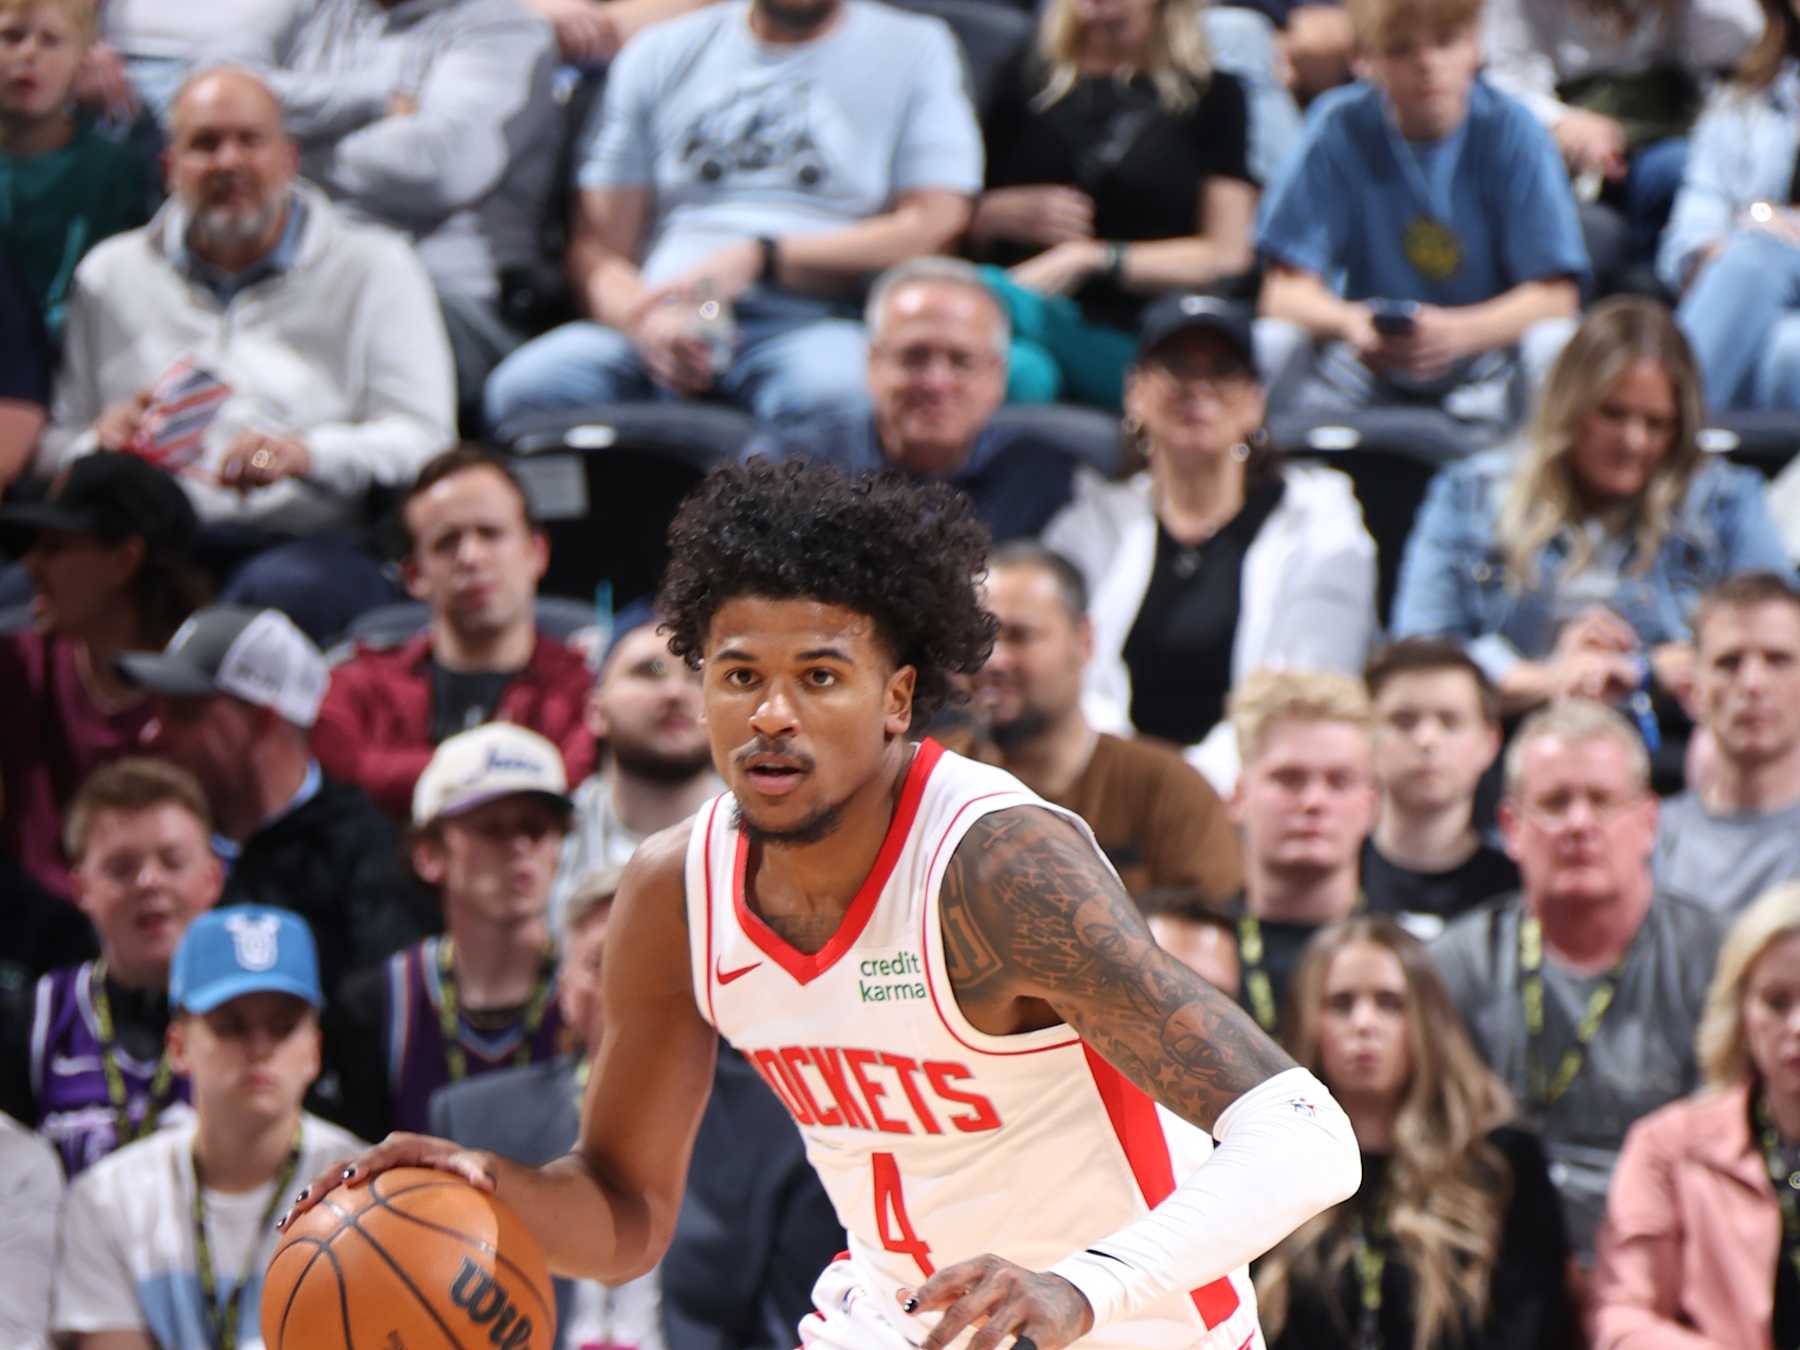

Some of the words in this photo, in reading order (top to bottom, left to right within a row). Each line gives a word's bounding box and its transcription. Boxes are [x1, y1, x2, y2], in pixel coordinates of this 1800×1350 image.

[859, 979, 927, 1002] karma
[860, 951, 921, 976] credit
[741, 1046, 1003, 1135] OCKETS
[872, 1152, 936, 1279] 4
